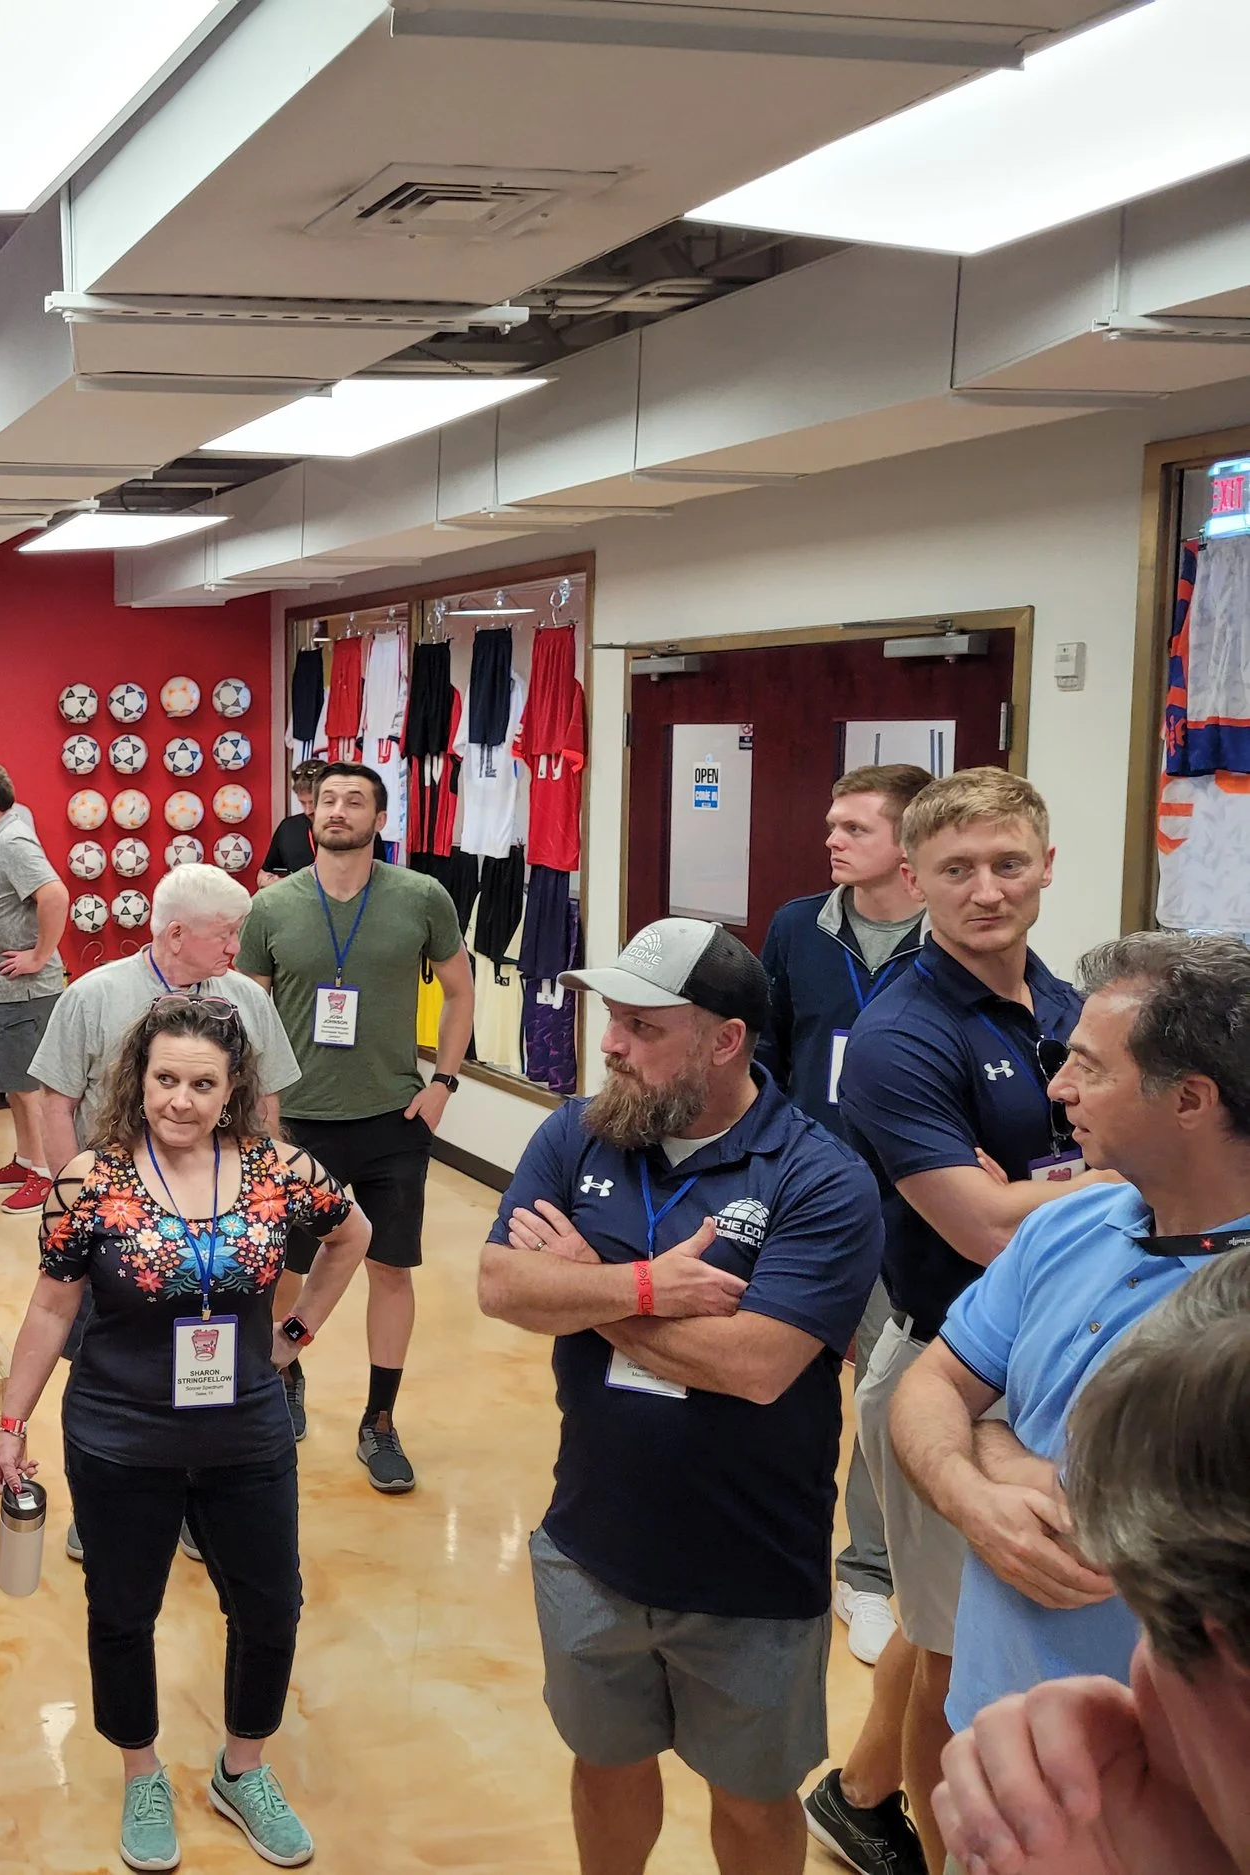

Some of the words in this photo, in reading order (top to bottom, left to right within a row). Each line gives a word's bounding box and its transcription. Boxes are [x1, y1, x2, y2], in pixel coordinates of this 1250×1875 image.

[694, 767, 719, 784] OPEN
[628, 946, 663, 966] DOME
[712, 1215, 742, 1232] THE
[744, 1225, 765, 1241] DO
[177, 1375, 233, 1385] STRINGFELLOW
[190, 1369, 220, 1377] SHARON
